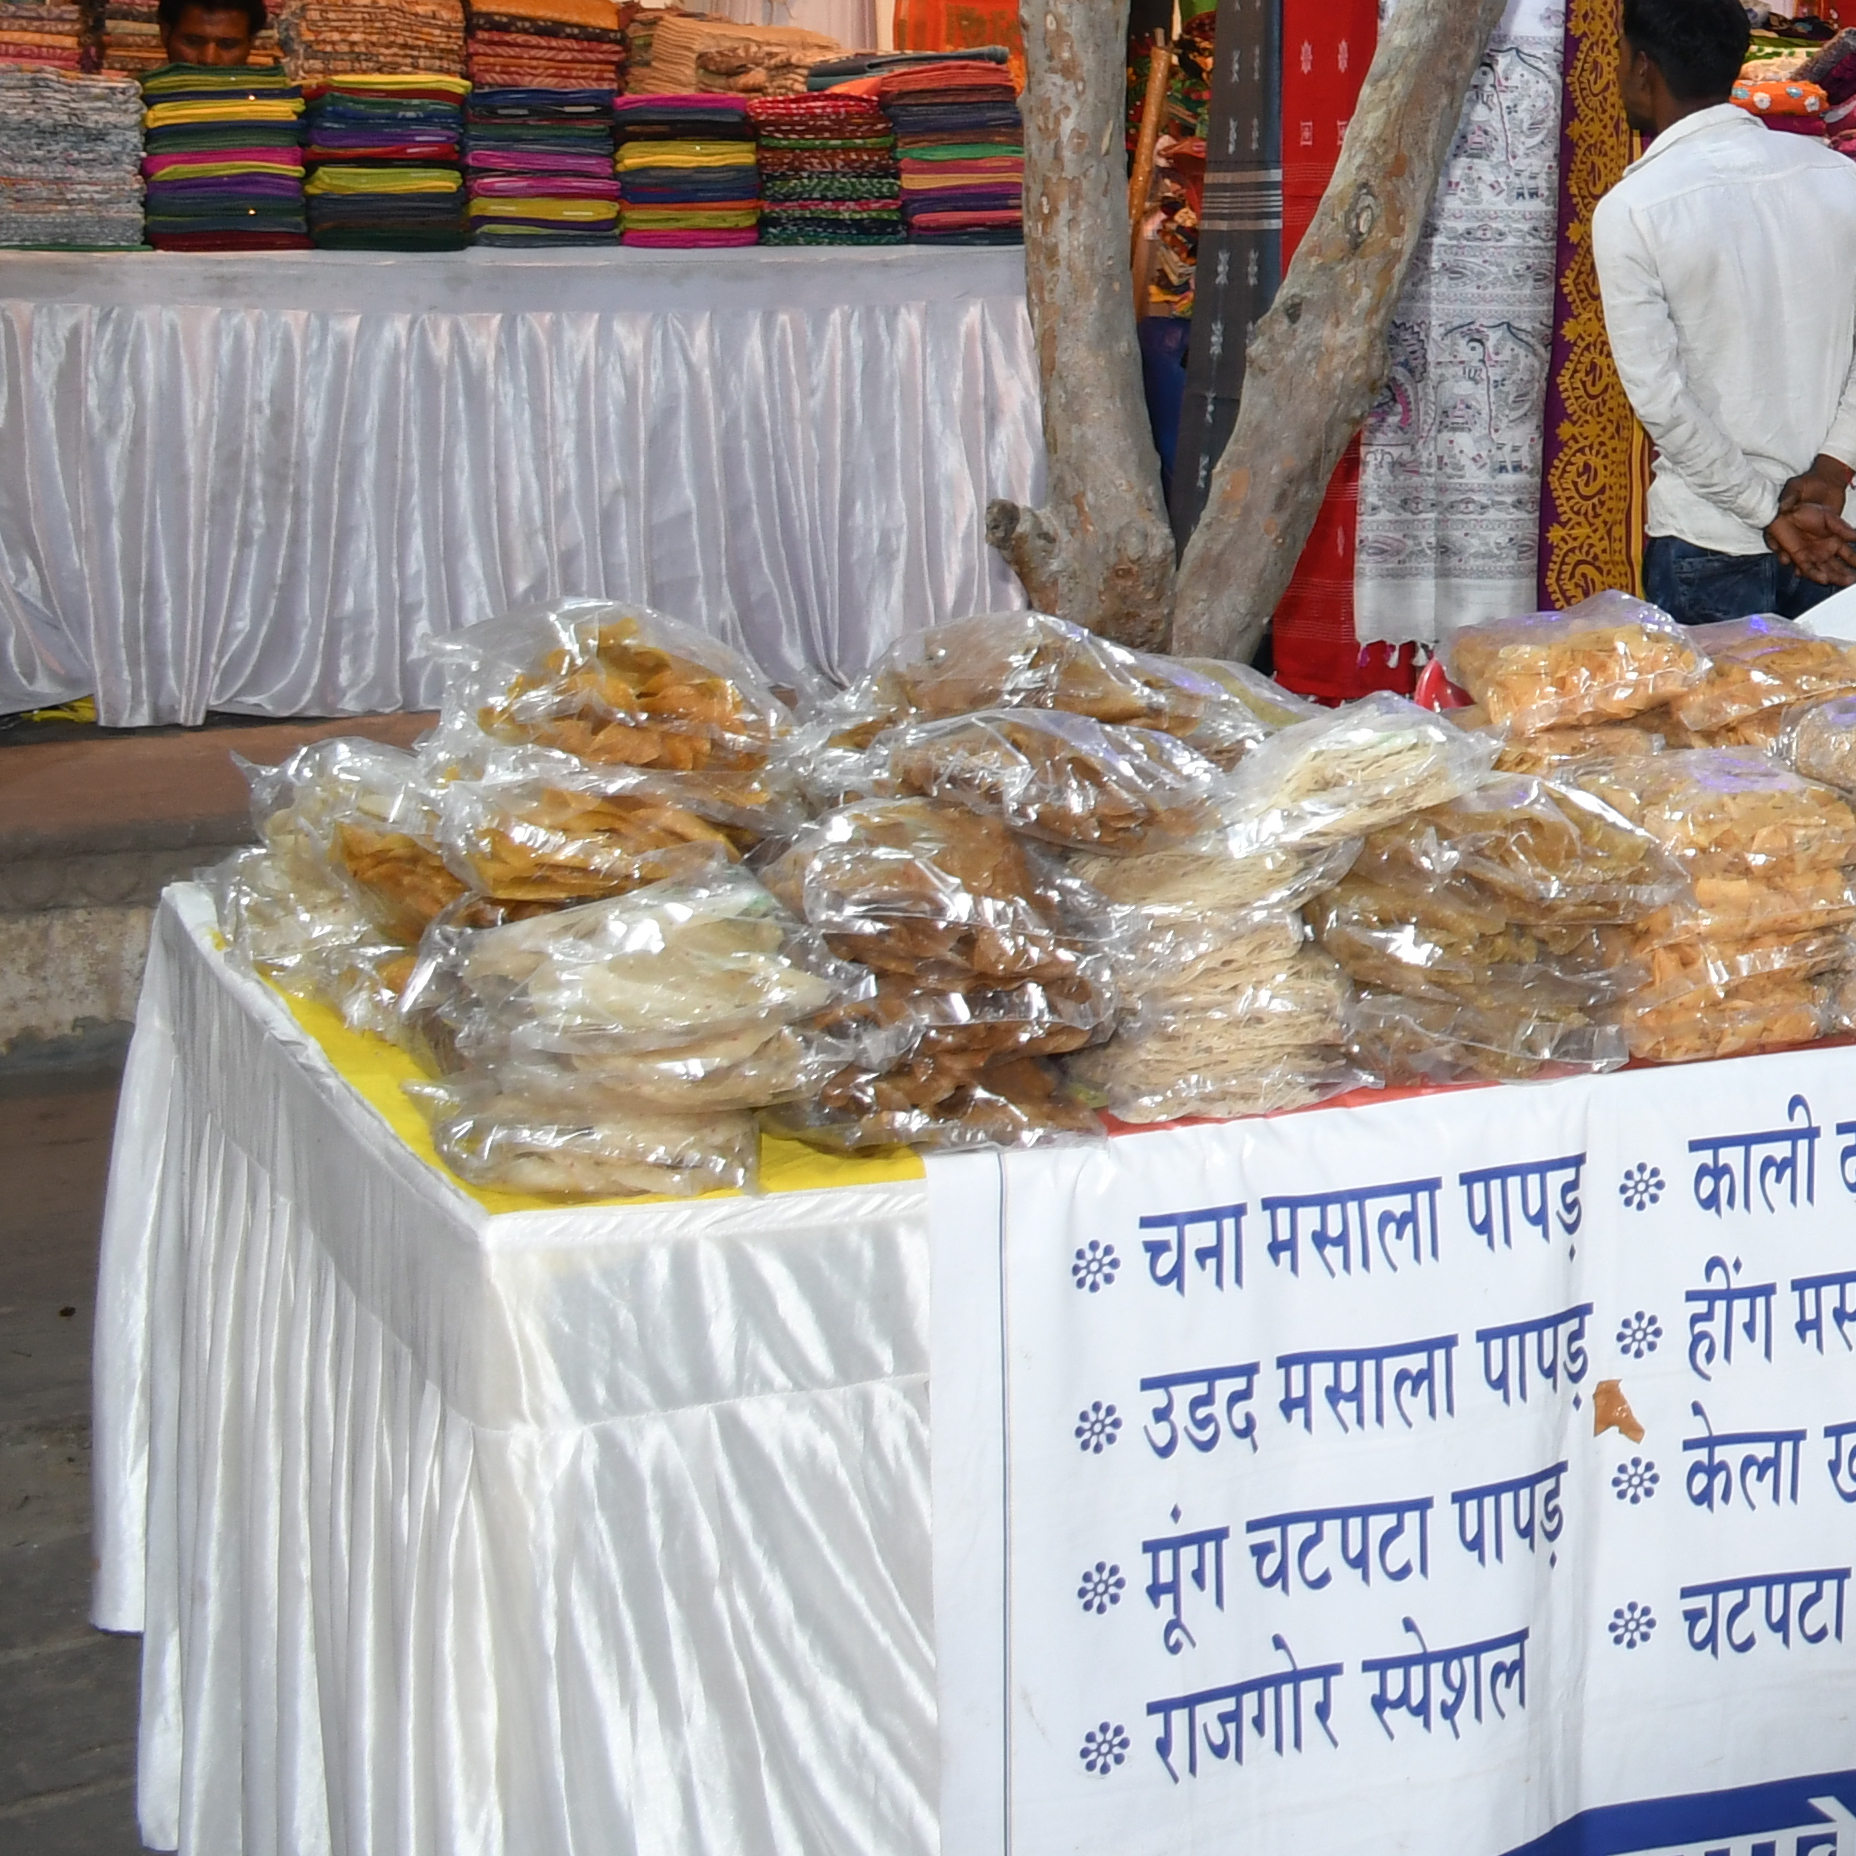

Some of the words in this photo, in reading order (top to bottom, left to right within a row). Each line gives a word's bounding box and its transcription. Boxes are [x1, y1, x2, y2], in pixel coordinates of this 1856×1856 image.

[1139, 1201, 1248, 1298] चना
[1261, 1176, 1442, 1279] मसाला
[1459, 1152, 1588, 1263] पापड़
[1688, 1094, 1821, 1219] काली
[1139, 1361, 1260, 1460] उडद
[1277, 1334, 1459, 1436] मसाला
[1476, 1301, 1594, 1411] पापड़
[1685, 1254, 1777, 1382] हींग
[1682, 1400, 1807, 1515] केला
[1142, 1503, 1230, 1657] मूंग
[1245, 1496, 1435, 1598] चटपटा
[1451, 1459, 1569, 1570] पापड़
[1680, 1567, 1852, 1662] चटपटा
[1146, 1634, 1344, 1786] राजगोर
[1361, 1617, 1530, 1742] स्पेशल
